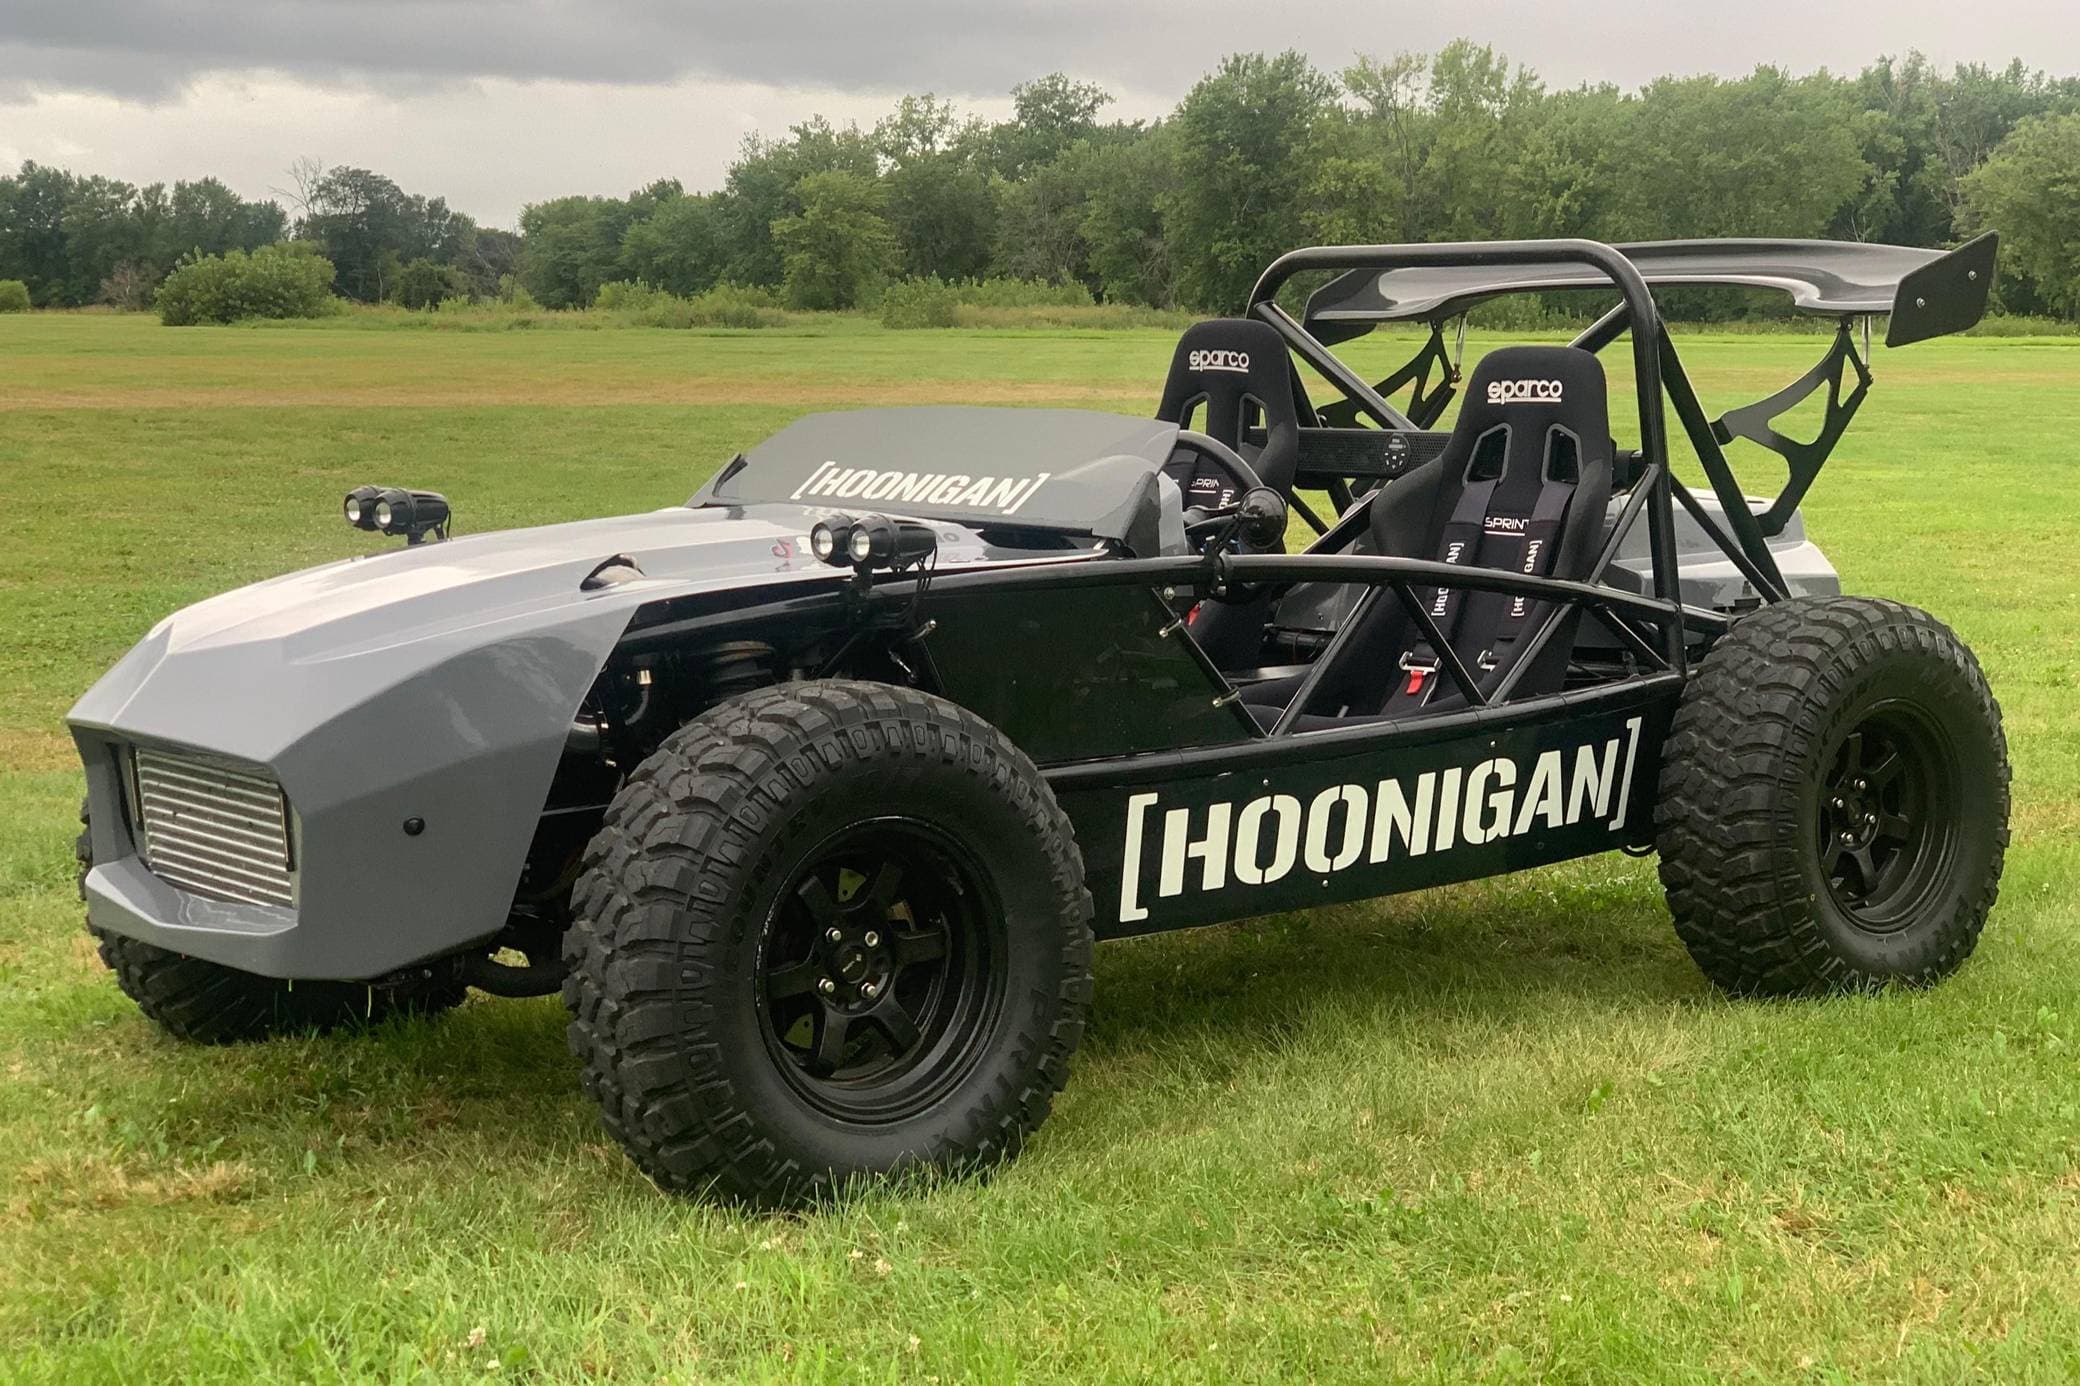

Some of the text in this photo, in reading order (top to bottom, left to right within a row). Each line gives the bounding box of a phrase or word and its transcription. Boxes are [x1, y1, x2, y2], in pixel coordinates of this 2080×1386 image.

[1189, 349, 1250, 373] sparco
[1486, 379, 1563, 405] sparco
[790, 460, 1051, 515] [HOONIGAN]
[1119, 716, 1642, 922] [HOONIGAN]
